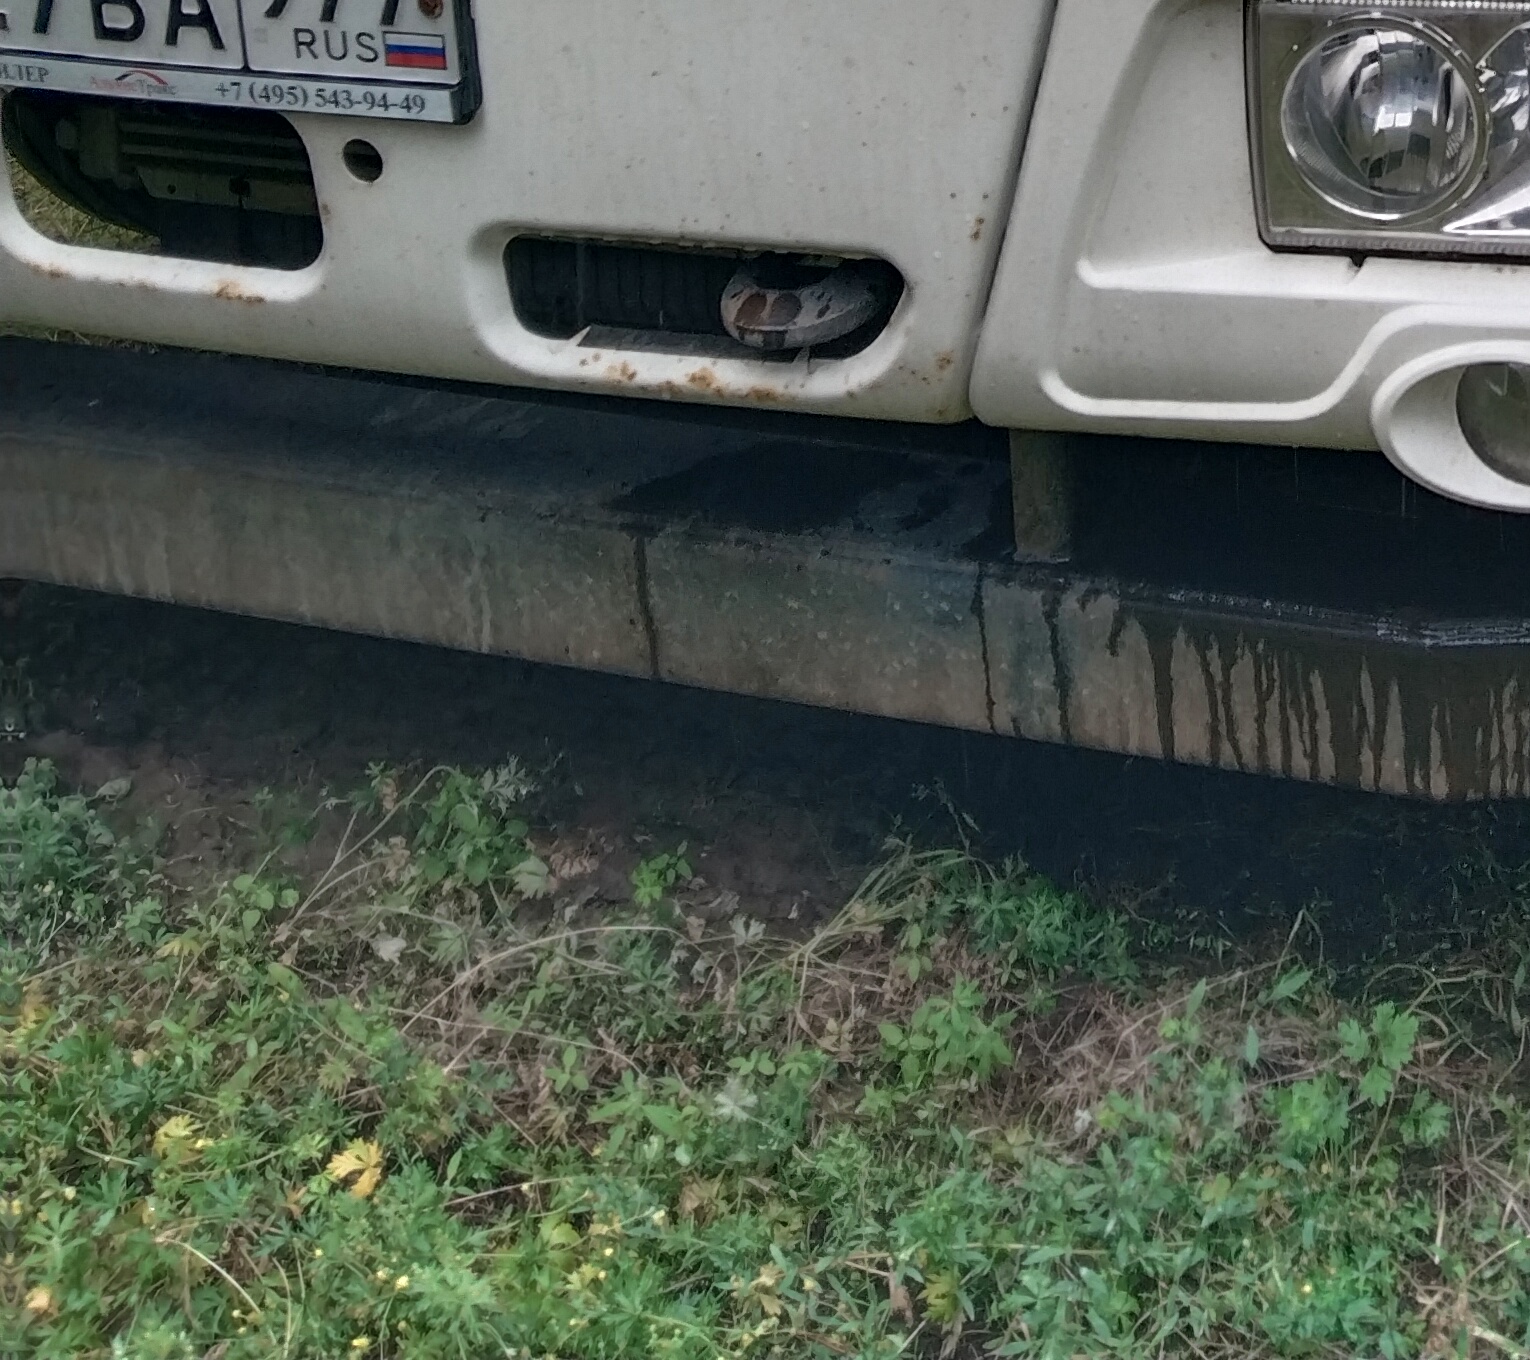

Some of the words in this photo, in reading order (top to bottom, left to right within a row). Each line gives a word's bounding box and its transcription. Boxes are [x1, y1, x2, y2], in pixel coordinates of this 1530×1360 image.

[293, 27, 379, 63] RUS
[215, 82, 241, 101] +7
[249, 81, 308, 107] (495)
[315, 88, 425, 114] 543-94-49
